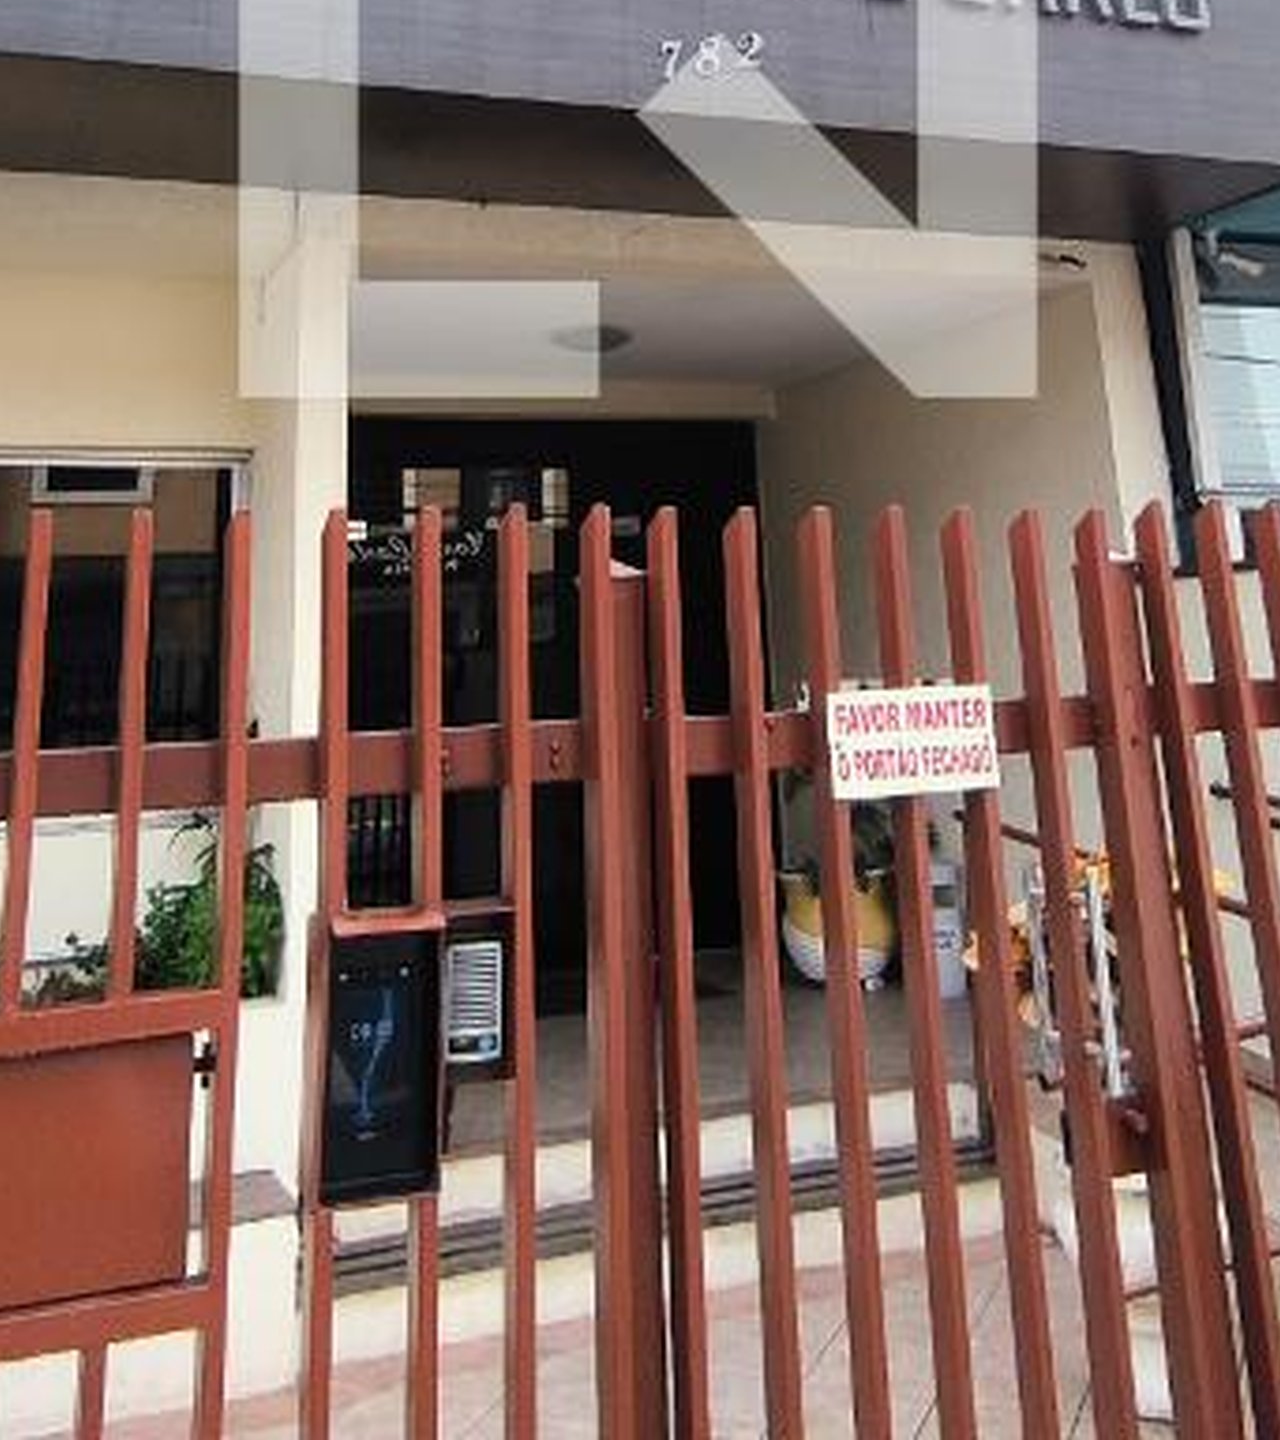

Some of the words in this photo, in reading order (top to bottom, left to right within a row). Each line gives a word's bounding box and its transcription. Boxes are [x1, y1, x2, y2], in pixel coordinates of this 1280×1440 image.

[660, 30, 765, 80] 782
[834, 702, 900, 735] FAVOR
[904, 698, 987, 731] MANTER
